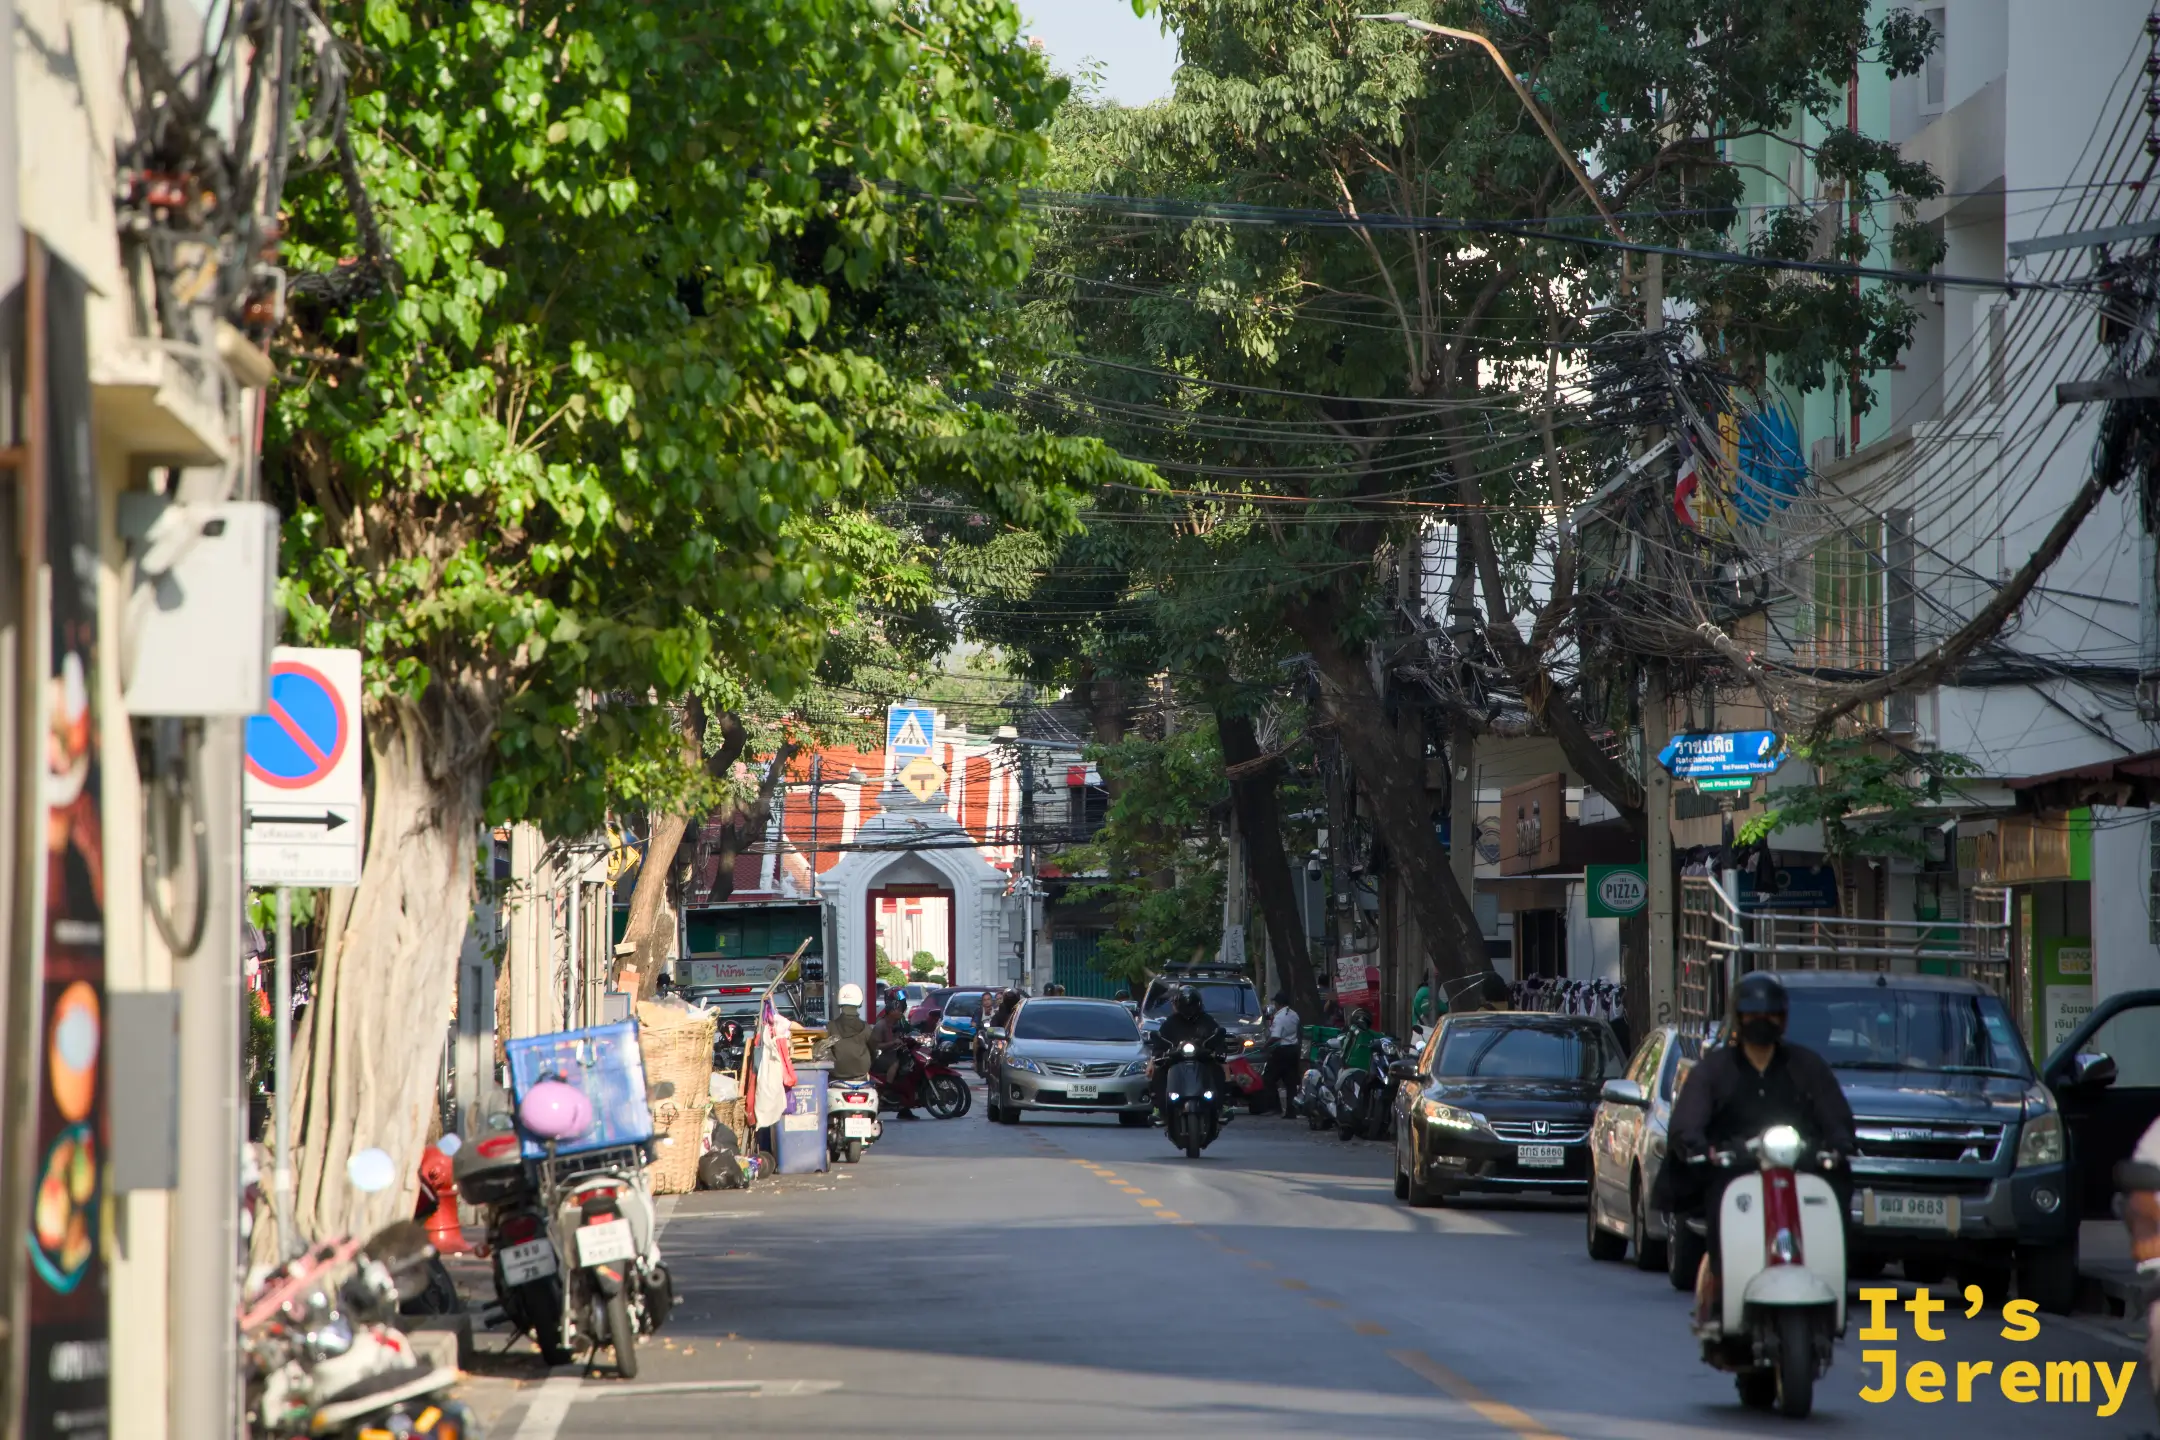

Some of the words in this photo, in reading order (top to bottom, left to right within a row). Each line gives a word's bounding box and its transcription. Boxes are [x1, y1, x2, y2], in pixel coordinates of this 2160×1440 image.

[1675, 755, 1726, 765] Ratchabophit
[1606, 884, 1640, 899] PIZZA
[1908, 1199, 1944, 1215] 9683
